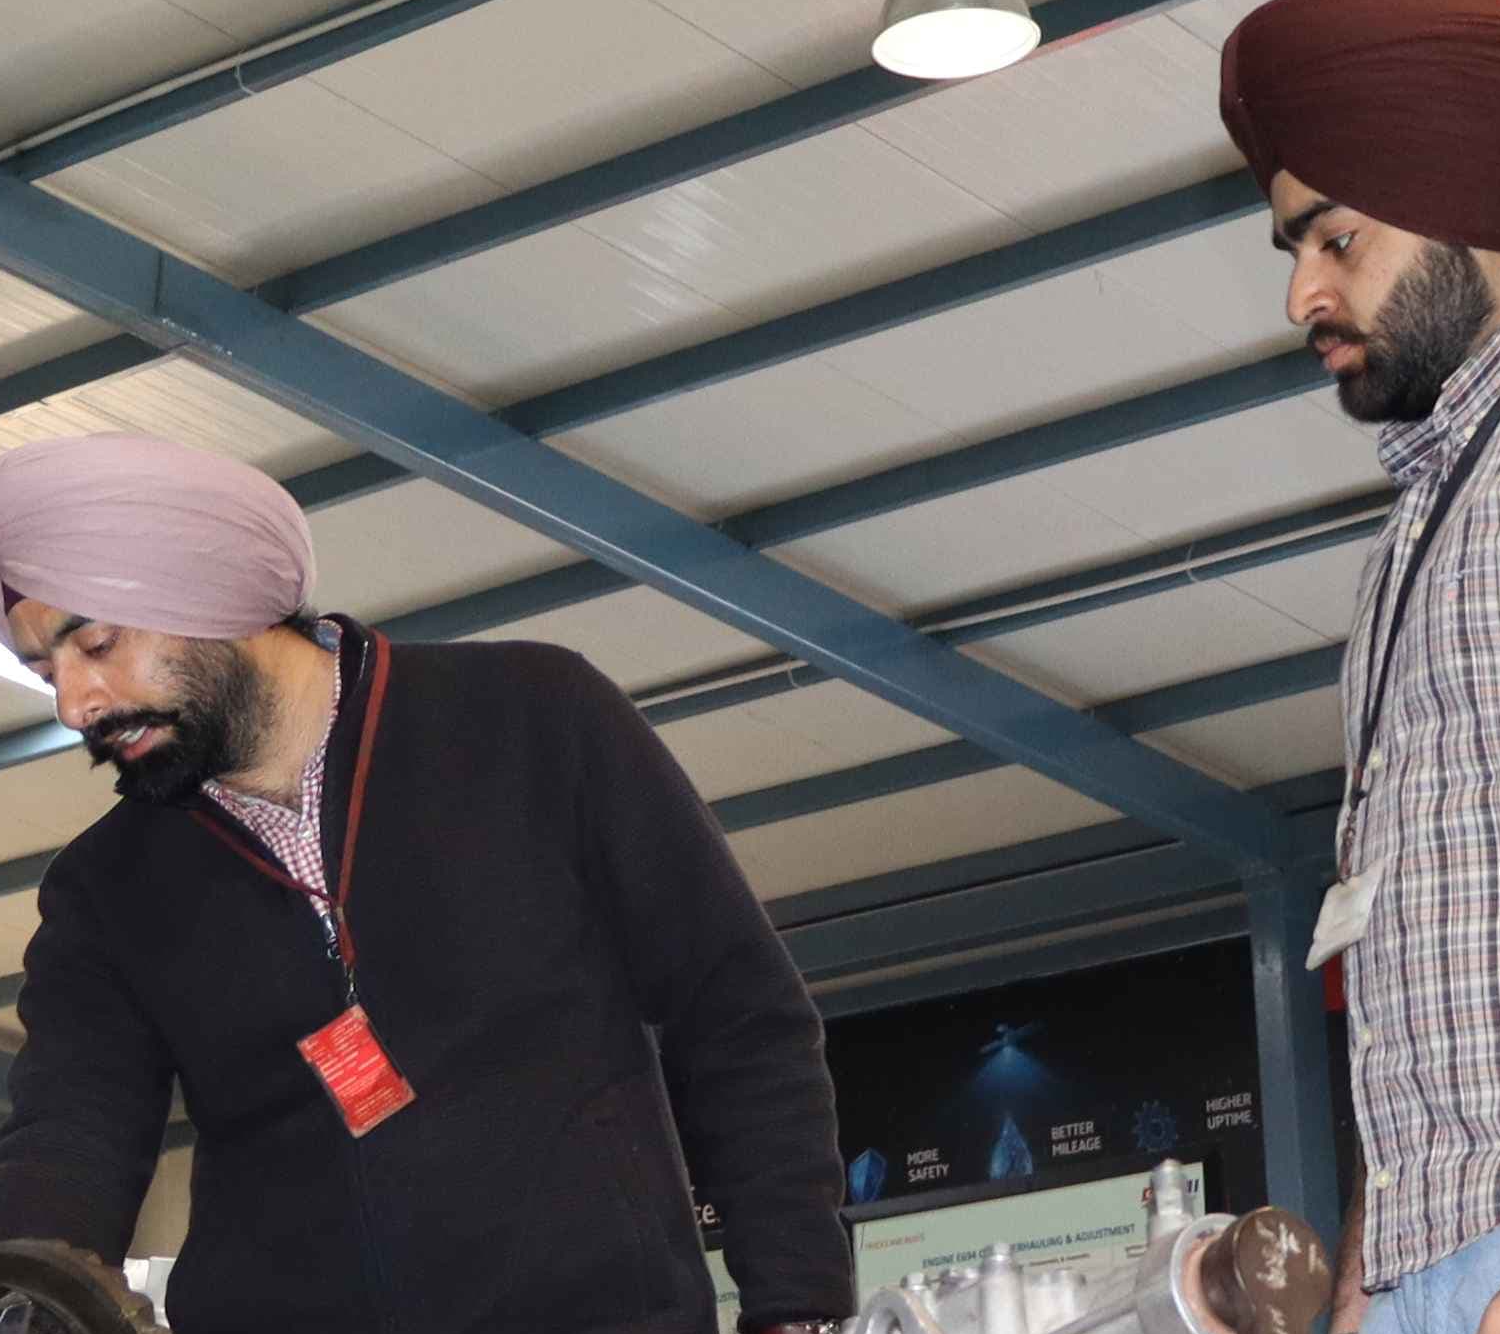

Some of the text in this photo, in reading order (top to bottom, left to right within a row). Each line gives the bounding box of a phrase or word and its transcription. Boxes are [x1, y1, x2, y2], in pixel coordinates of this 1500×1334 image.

[1205, 1092, 1252, 1113] HIGHER
[1051, 1121, 1095, 1141] BETTER
[907, 1147, 940, 1166] MORE
[1052, 1136, 1102, 1157] MILEAGE
[908, 1163, 950, 1183] SAFETY
